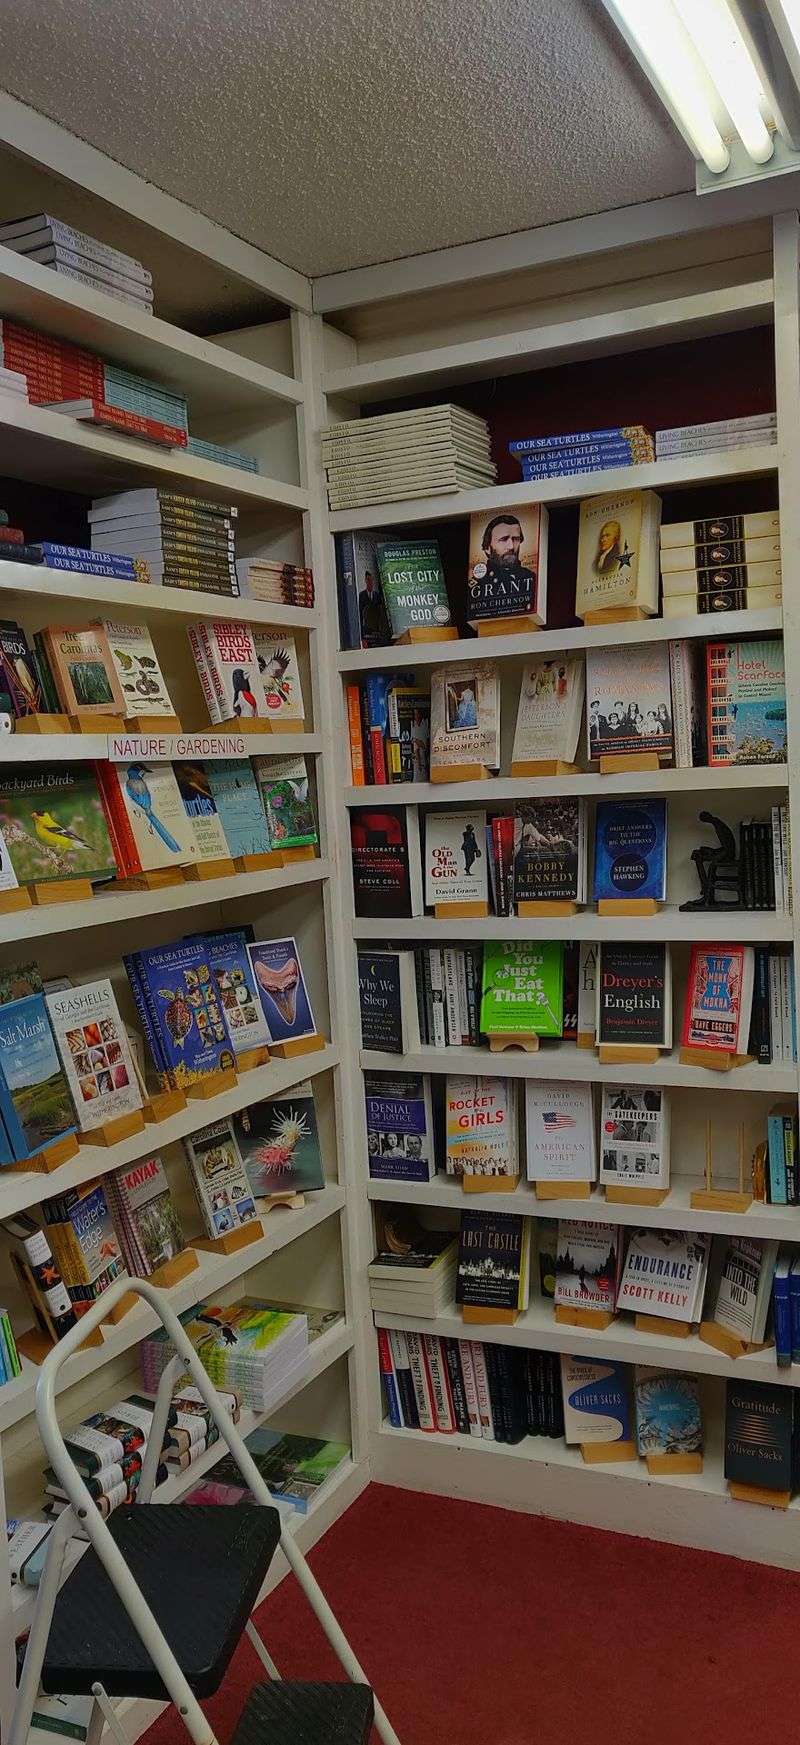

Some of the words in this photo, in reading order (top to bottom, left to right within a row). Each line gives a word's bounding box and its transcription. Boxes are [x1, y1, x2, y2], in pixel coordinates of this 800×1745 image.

[517, 442, 535, 450] OUR
[554, 434, 590, 445] TURTLES
[528, 454, 546, 463] OUR
[547, 452, 562, 460] SEA
[564, 445, 599, 456] TURTLES
[530, 464, 547, 473] OUR
[566, 455, 600, 466] TURTLES
[550, 471, 564, 479] SEA
[567, 465, 601, 476] TURTLES
[51, 544, 68, 555] OUR
[68, 547, 82, 558] SEA
[82, 550, 112, 563] TURTLES
[54, 558, 70, 569] OUR
[71, 561, 85, 571] SEA
[85, 563, 114, 576] TURTLES
[388, 571, 413, 584] LOST
[417, 570, 440, 582] CITY
[471, 577, 533, 599] GRANT
[583, 576, 631, 596] HAMILTON
[397, 593, 439, 607] MONKEY
[471, 600, 488, 610] RON
[490, 596, 531, 608] CHERNOW
[411, 609, 432, 621] GOD
[213, 623, 248, 635] SIBLEY
[252, 632, 288, 641] erson
[2, 640, 27, 656] BIRDS
[199, 625, 213, 659] SIBLEY
[217, 635, 251, 648] BIRDS
[219, 648, 253, 662] EAST
[737, 660, 767, 670] Hotel
[200, 672, 214, 701] BIRDS
[210, 667, 224, 695] BIRDS
[439, 733, 487, 743] SOUTHERN
[114, 739, 167, 756] NATURE
[177, 739, 245, 755] GARDENING
[434, 741, 491, 753] DISCOMFORT
[0, 775, 45, 791] ackyard
[47, 773, 75, 786] Birds
[608, 839, 618, 847] BIG
[620, 838, 652, 847] QUESTIONS
[431, 850, 453, 859] OLD
[437, 857, 457, 867] Man
[431, 867, 458, 878] GUN
[527, 861, 565, 872] BOBBY
[614, 865, 645, 873] STEPHEN
[518, 872, 575, 883] KENNEDY
[613, 872, 645, 881] HAWKING
[435, 887, 456, 896] David
[537, 889, 577, 897] MATTHEWS
[148, 955, 163, 966] OUR
[162, 952, 177, 963] SEA
[177, 945, 205, 959] TURTLES
[503, 941, 534, 955] Did
[513, 952, 544, 964] You
[496, 964, 537, 979] Just
[712, 960, 726, 972] THE
[515, 977, 544, 990] Eat
[603, 974, 664, 993] Dreyer's
[709, 971, 728, 983] MONK
[358, 979, 378, 994] Why
[380, 980, 395, 993] We
[712, 983, 722, 997] OF
[54, 990, 111, 1015] SEASHELLS
[364, 994, 389, 1010] Sleep
[604, 994, 661, 1013] English
[702, 997, 729, 1011] MOKHA
[0, 1031, 18, 1048] Salt
[17, 1020, 46, 1041] Marsh
[694, 1021, 710, 1031] DAVE
[711, 1021, 733, 1032] EGGERS
[370, 1101, 411, 1115] DENIAL
[448, 1096, 496, 1112] ROCKET
[371, 1113, 382, 1121] OF
[383, 1113, 412, 1123] JUSTICE
[459, 1111, 505, 1129] GIRLS
[615, 1111, 658, 1121] GATEKEEPERS
[534, 1143, 586, 1151] AMERICAN
[543, 1153, 577, 1162] SPIRIT
[124, 1160, 159, 1190] KAYAK
[80, 1226, 104, 1254] Edge
[462, 1231, 484, 1248] LAST
[488, 1232, 520, 1251] CASTLE
[628, 1254, 694, 1281] ENDURANCE
[726, 1264, 743, 1283] INTO
[744, 1275, 758, 1292] THE
[558, 1287, 572, 1296] BILL
[574, 1289, 609, 1303] BROWDER
[622, 1284, 654, 1300] SCOTT
[657, 1292, 689, 1307] KELLY
[729, 1285, 748, 1306] WILD
[431, 1360, 440, 1380] THEFT
[474, 1360, 485, 1380] AND
[412, 1359, 421, 1378] THEFT
[417, 1384, 427, 1411] FINDING
[434, 1385, 445, 1412] FINDING
[575, 1395, 598, 1406] OLIVER
[600, 1394, 621, 1405] SACKS
[732, 1397, 783, 1416] Gratitude
[727, 1442, 756, 1456] Oliver
[759, 1448, 784, 1463] Sacks
